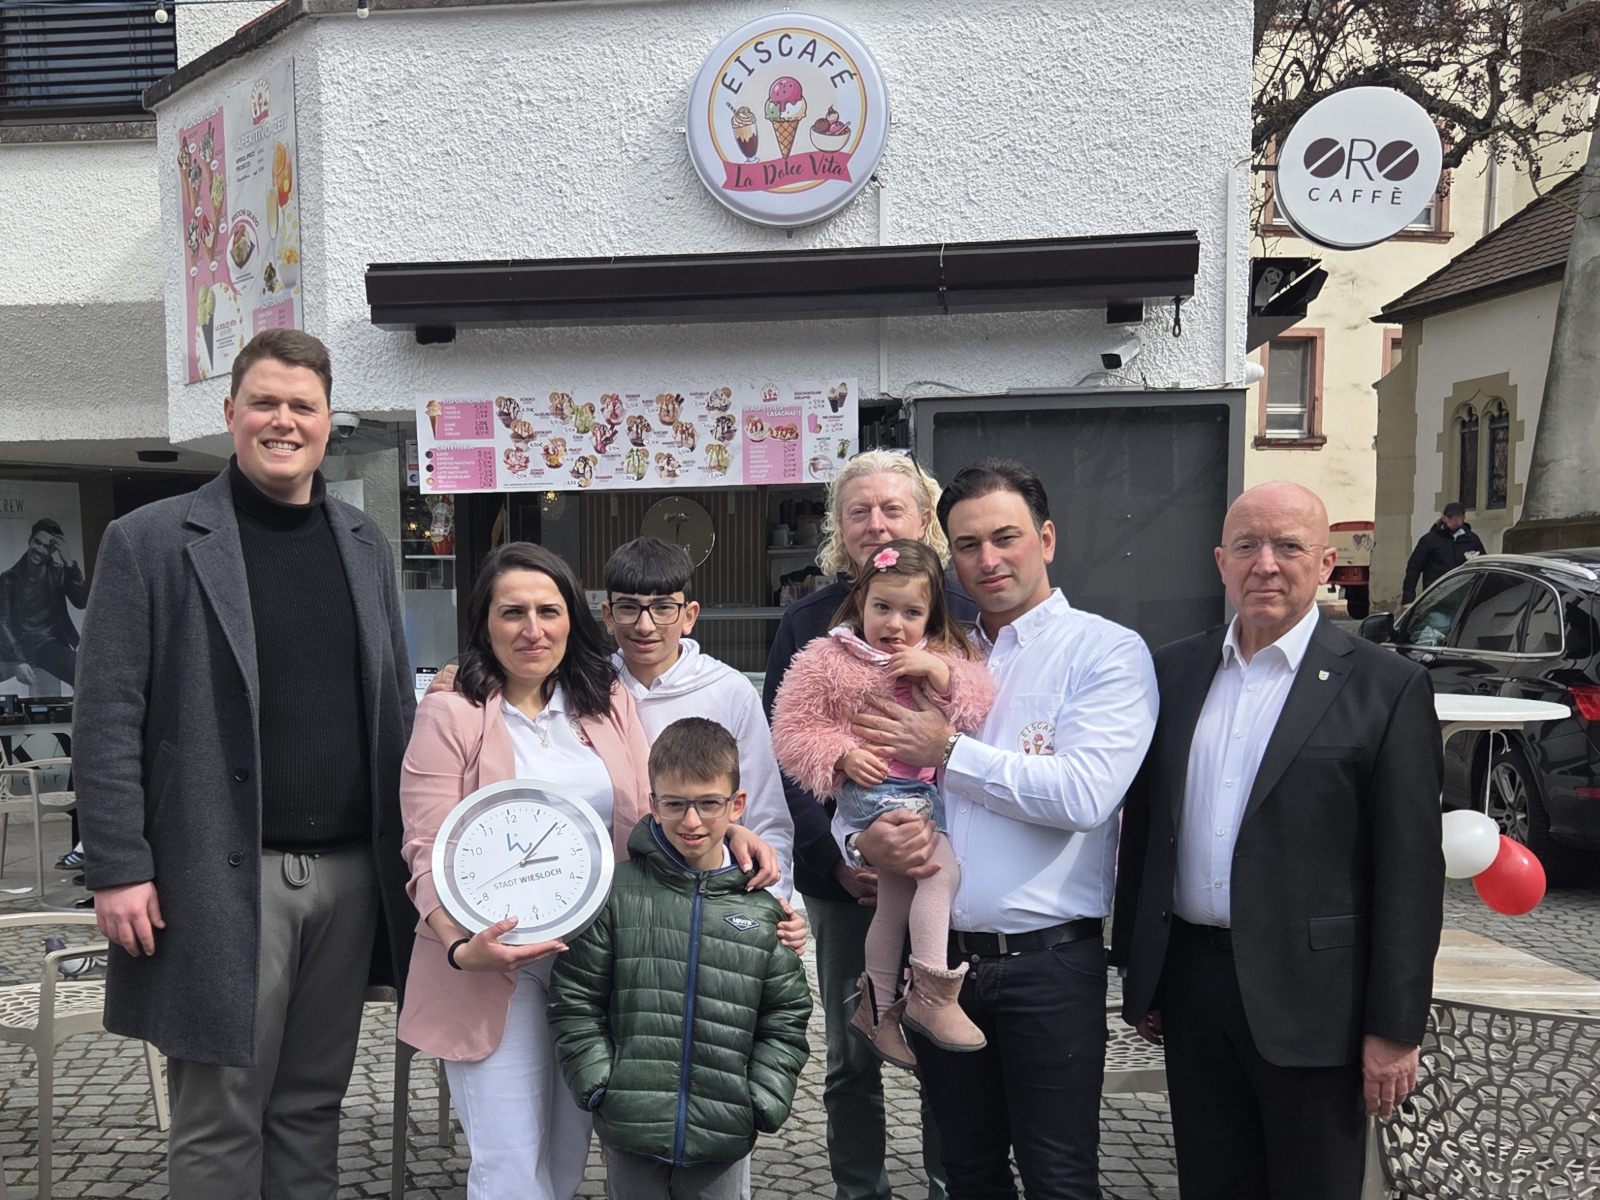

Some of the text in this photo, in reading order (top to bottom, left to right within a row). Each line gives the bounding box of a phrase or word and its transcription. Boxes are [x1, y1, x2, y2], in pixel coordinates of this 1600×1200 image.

[721, 33, 857, 95] EISCAFÉ
[236, 114, 289, 150] APERITIVO-ZEIT
[1303, 137, 1420, 182] ORO
[734, 154, 845, 188] La Dolce Vita
[1308, 187, 1403, 206] CAFFÈ
[0, 499, 25, 513] REW
[505, 814, 518, 824] 12
[532, 814, 539, 823] 1
[482, 826, 495, 837] 11
[555, 826, 563, 836] 2
[470, 846, 483, 857] 10
[570, 847, 577, 856] 3
[468, 871, 476, 881] 9
[493, 867, 563, 891] STADT WIESLOCH
[568, 871, 576, 880] 4
[482, 892, 490, 902] 8
[554, 891, 562, 901] 5
[504, 903, 511, 913] 7
[531, 904, 539, 914] 6
